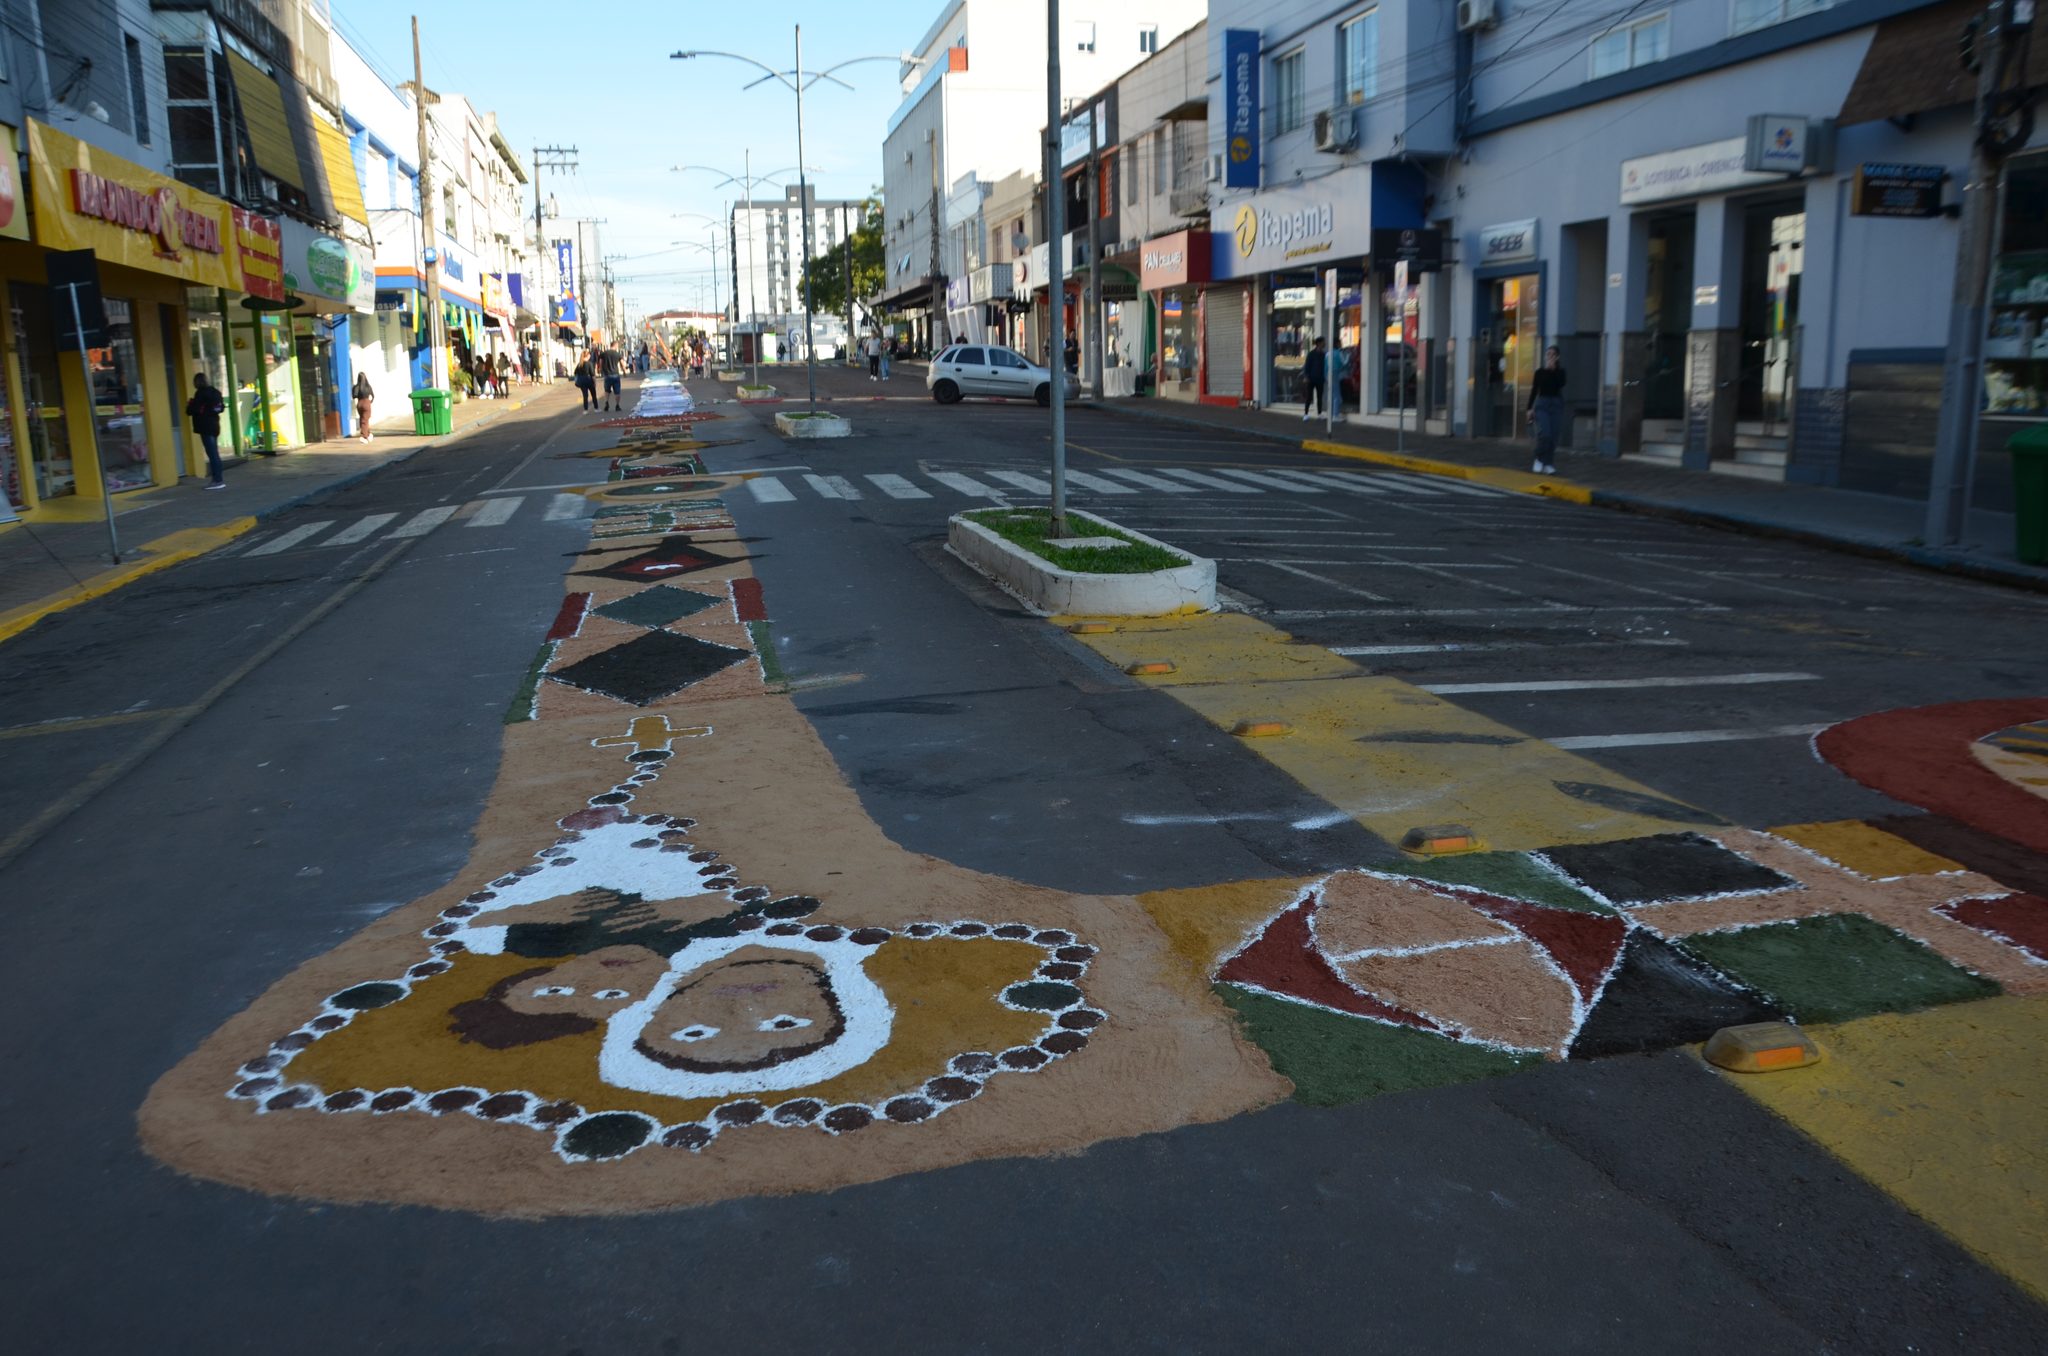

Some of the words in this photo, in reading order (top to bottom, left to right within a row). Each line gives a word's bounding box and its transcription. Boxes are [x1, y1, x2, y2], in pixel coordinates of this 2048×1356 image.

[1232, 52, 1253, 133] itapema
[74, 168, 160, 235] MUNDO
[181, 208, 225, 255] REAL
[1260, 202, 1333, 252] itapema
[1145, 250, 1160, 272] PAN
